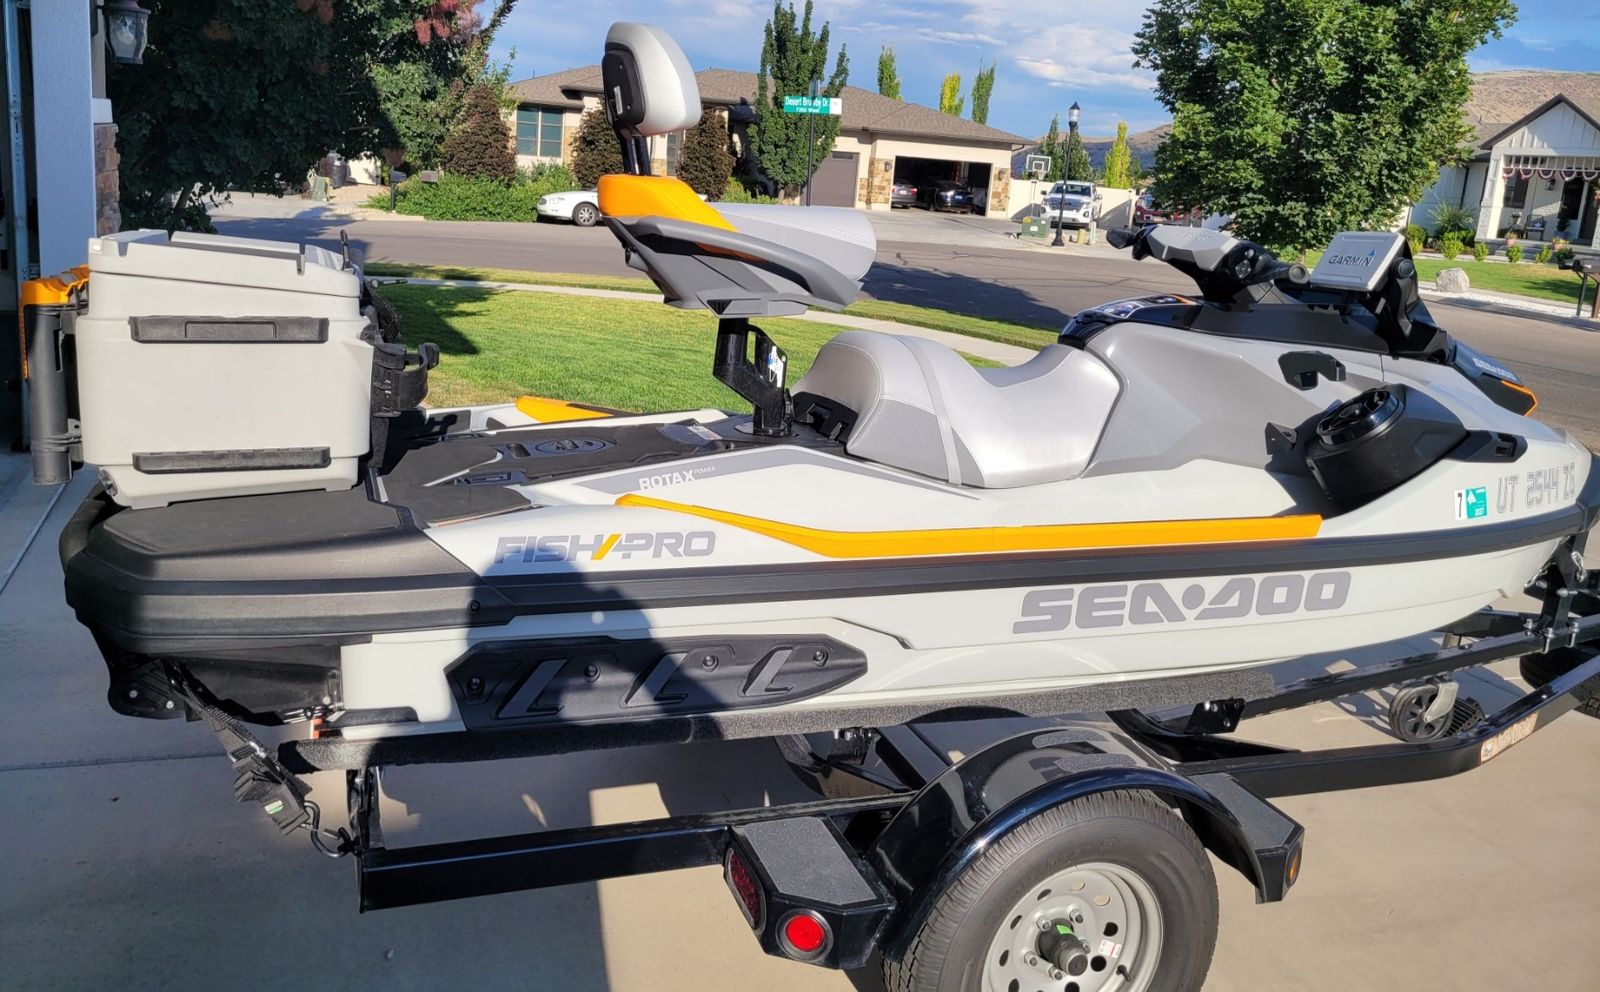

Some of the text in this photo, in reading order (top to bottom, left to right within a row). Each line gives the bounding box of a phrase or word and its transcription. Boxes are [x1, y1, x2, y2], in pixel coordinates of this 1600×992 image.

[785, 96, 802, 106] Desert
[1328, 255, 1373, 266] GARMIN
[638, 465, 716, 490] ROTAX POWER
[1496, 474, 1519, 513] UT
[1526, 466, 1559, 509] 2544
[1457, 492, 1463, 518] 7
